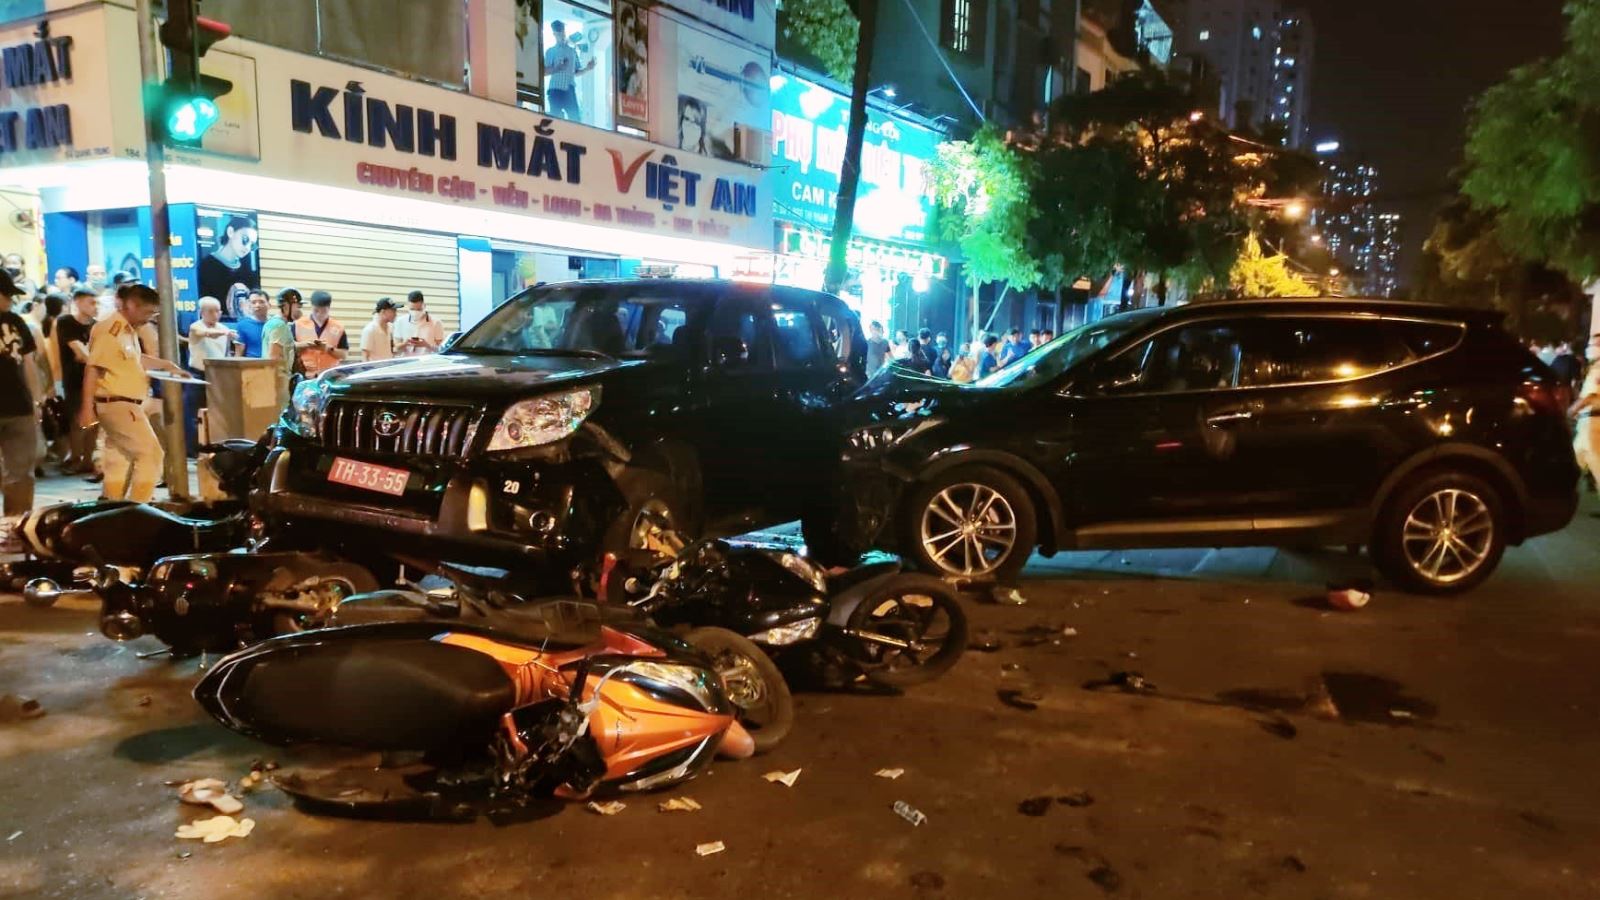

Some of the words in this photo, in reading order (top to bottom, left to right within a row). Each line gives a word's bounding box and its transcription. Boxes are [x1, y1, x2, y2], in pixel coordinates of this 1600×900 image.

[290, 79, 457, 161] KÍNH
[477, 119, 587, 184] MẮT
[606, 148, 702, 211] VIỆT
[711, 177, 757, 217] AN
[356, 161, 434, 194] CHUYÊN
[791, 181, 825, 206] CAM
[334, 460, 407, 492] TH-33-55
[503, 479, 520, 494] 20
